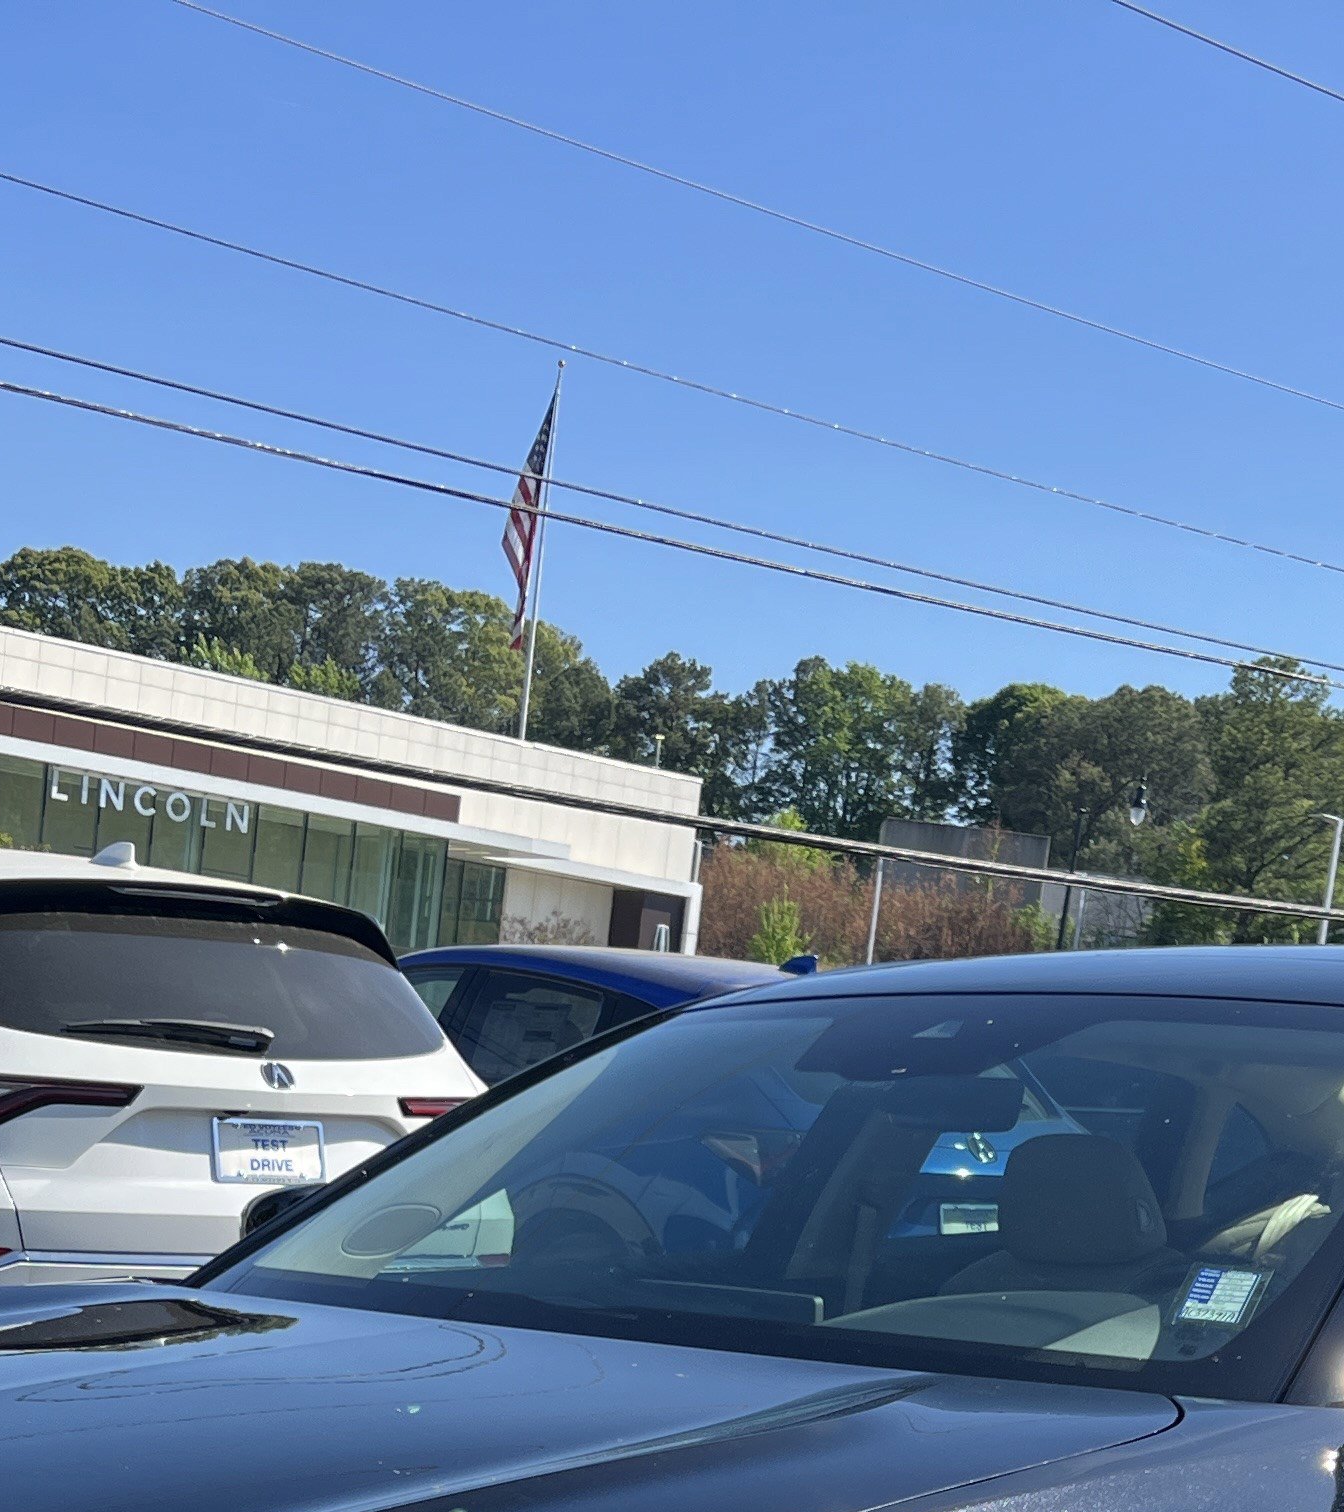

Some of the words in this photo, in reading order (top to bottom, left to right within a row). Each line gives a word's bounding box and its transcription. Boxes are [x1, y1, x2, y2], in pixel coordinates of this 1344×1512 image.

[51, 767, 250, 834] LINCOLN
[251, 1138, 288, 1152] TEST
[250, 1158, 294, 1171] DRIVE
